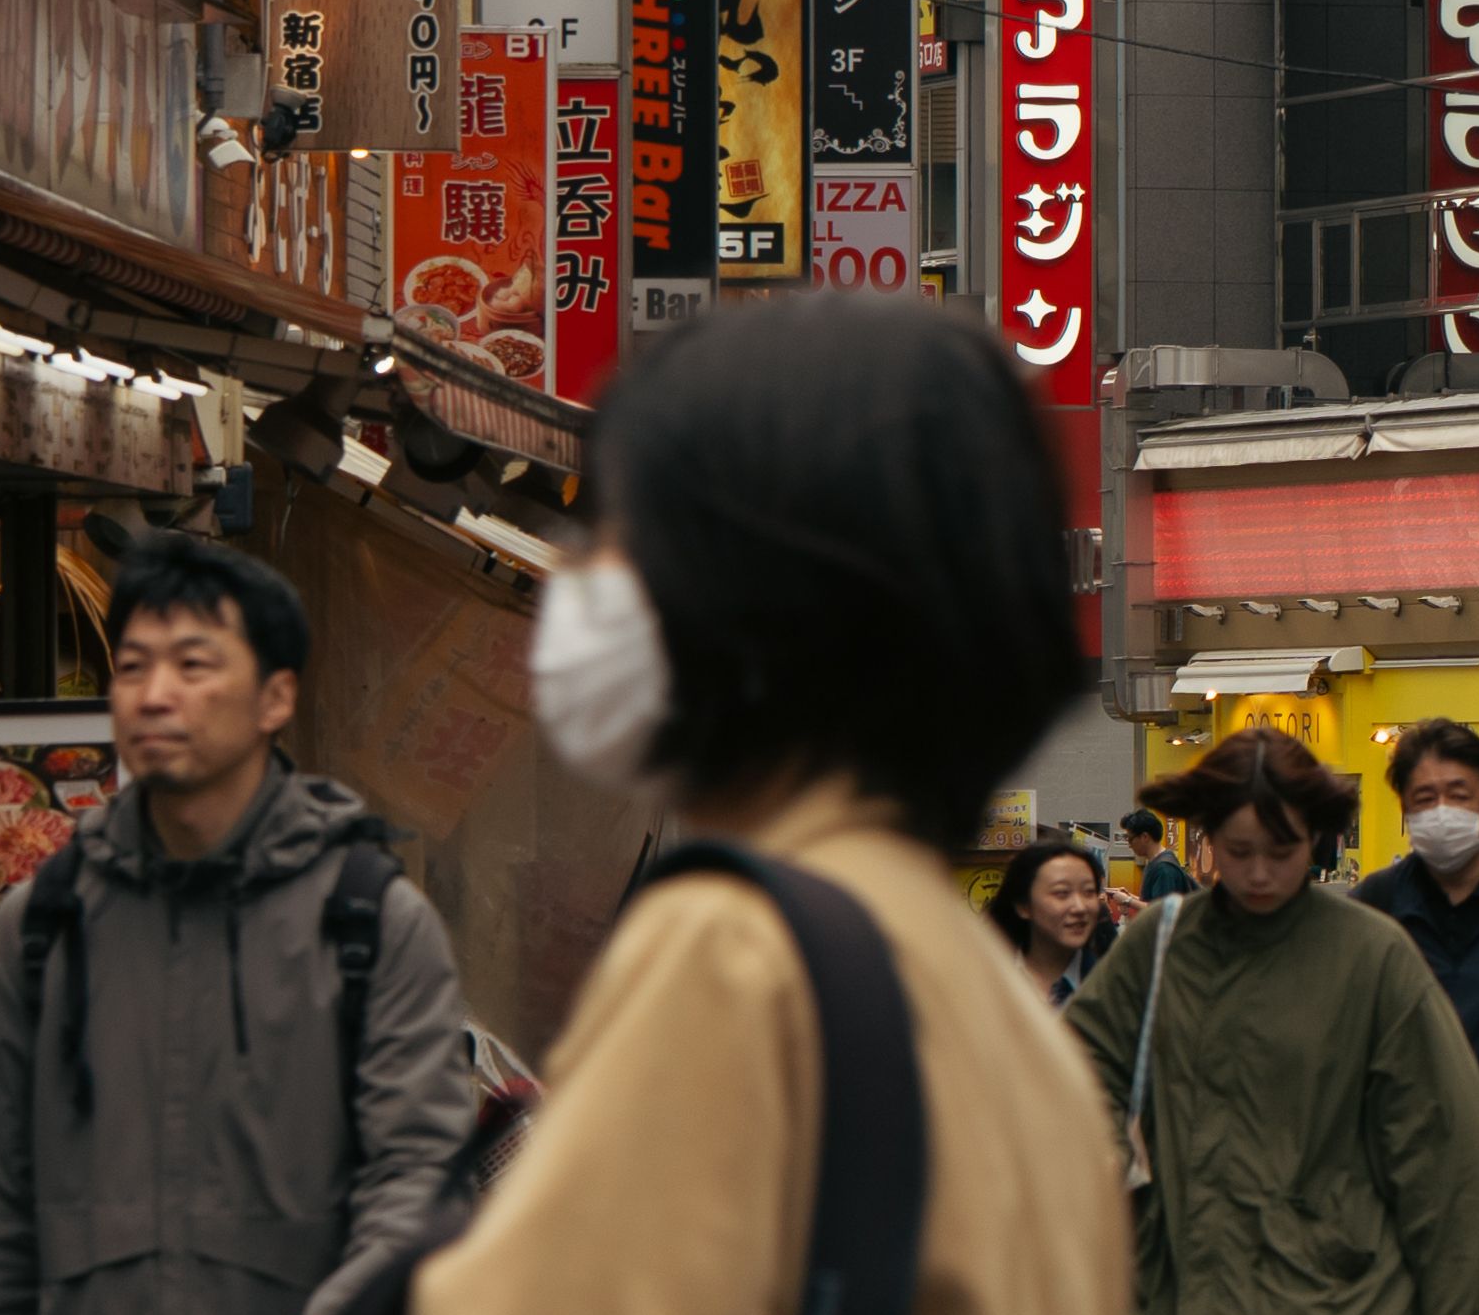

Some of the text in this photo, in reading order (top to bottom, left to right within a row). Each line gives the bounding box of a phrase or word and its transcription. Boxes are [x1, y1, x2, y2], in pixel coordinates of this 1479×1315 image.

[505, 33, 547, 59] B1
[830, 48, 864, 73] 3F
[280, 12, 324, 134] 新宿店
[556, 97, 613, 313] 立呑み
[815, 181, 907, 213] IZZA
[645, 287, 702, 321] Bar
